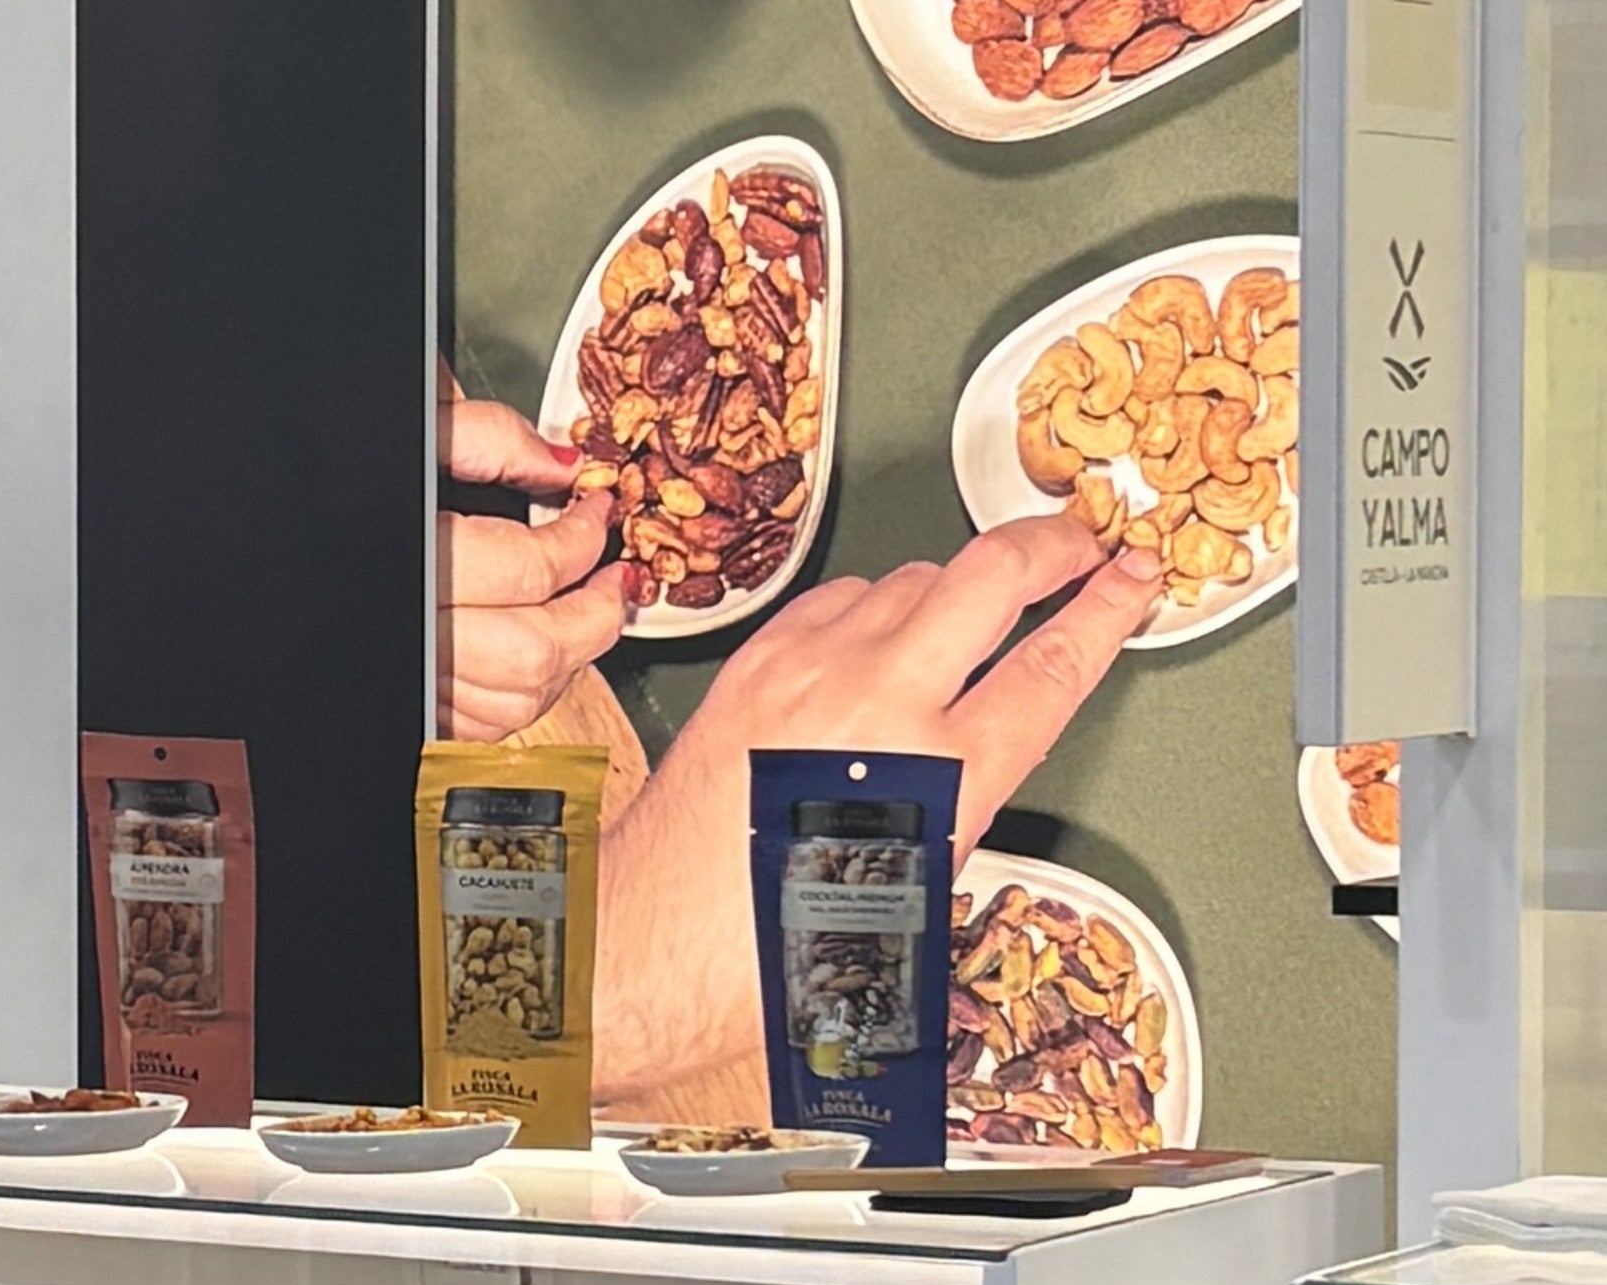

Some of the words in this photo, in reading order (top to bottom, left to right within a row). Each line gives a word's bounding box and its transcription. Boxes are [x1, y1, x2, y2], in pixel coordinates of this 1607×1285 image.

[1362, 428, 1450, 478] CAMPO
[1362, 497, 1449, 548] YALMA
[471, 1068, 511, 1082] FINCA
[471, 1081, 538, 1102] ROSALA
